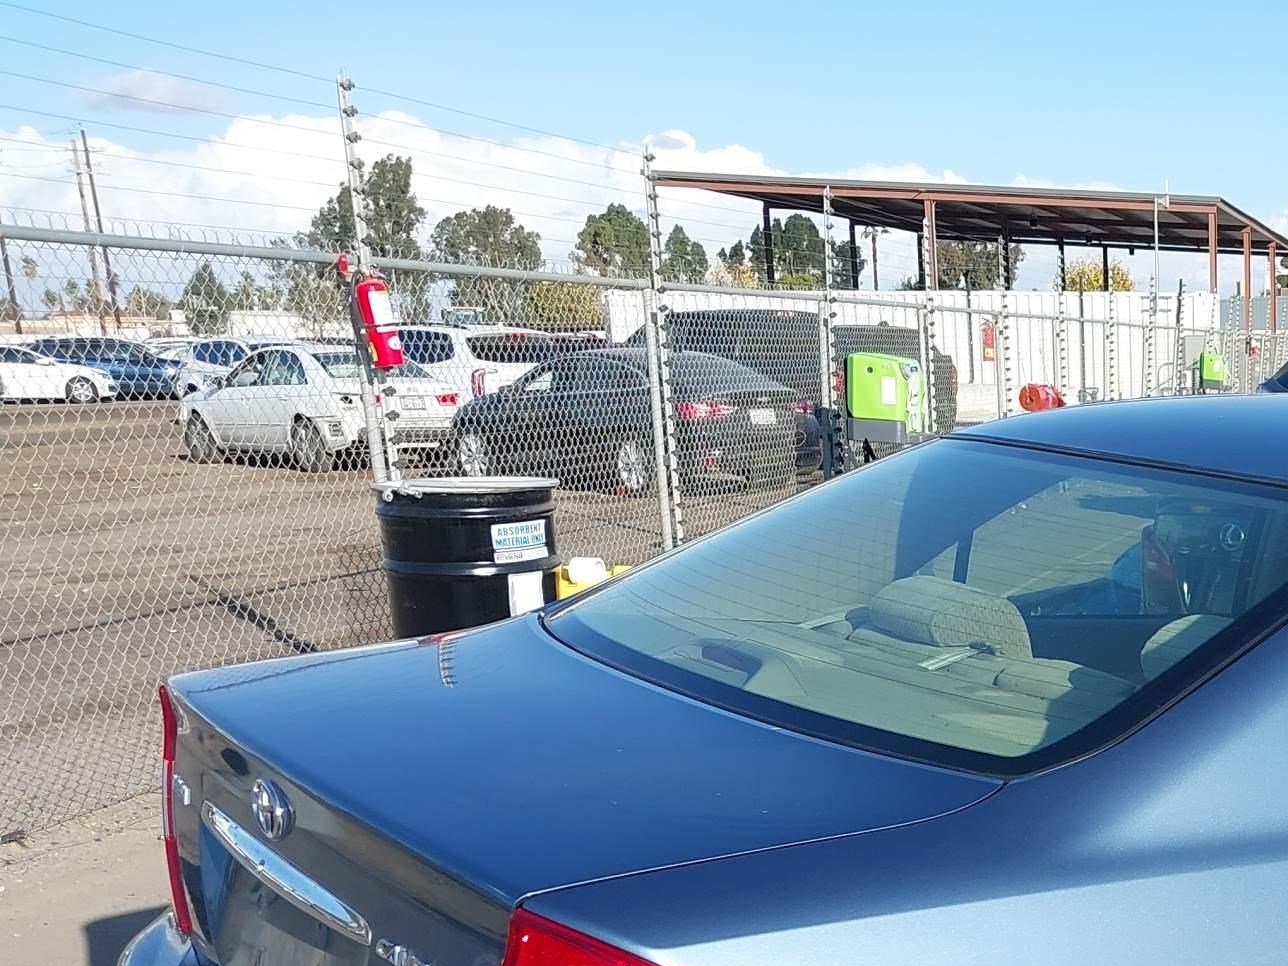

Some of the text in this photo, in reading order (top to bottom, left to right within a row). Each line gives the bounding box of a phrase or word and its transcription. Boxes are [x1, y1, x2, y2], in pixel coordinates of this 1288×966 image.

[497, 523, 541, 537] ABSORBENT
[496, 533, 544, 547] MATERIAL ONLY
